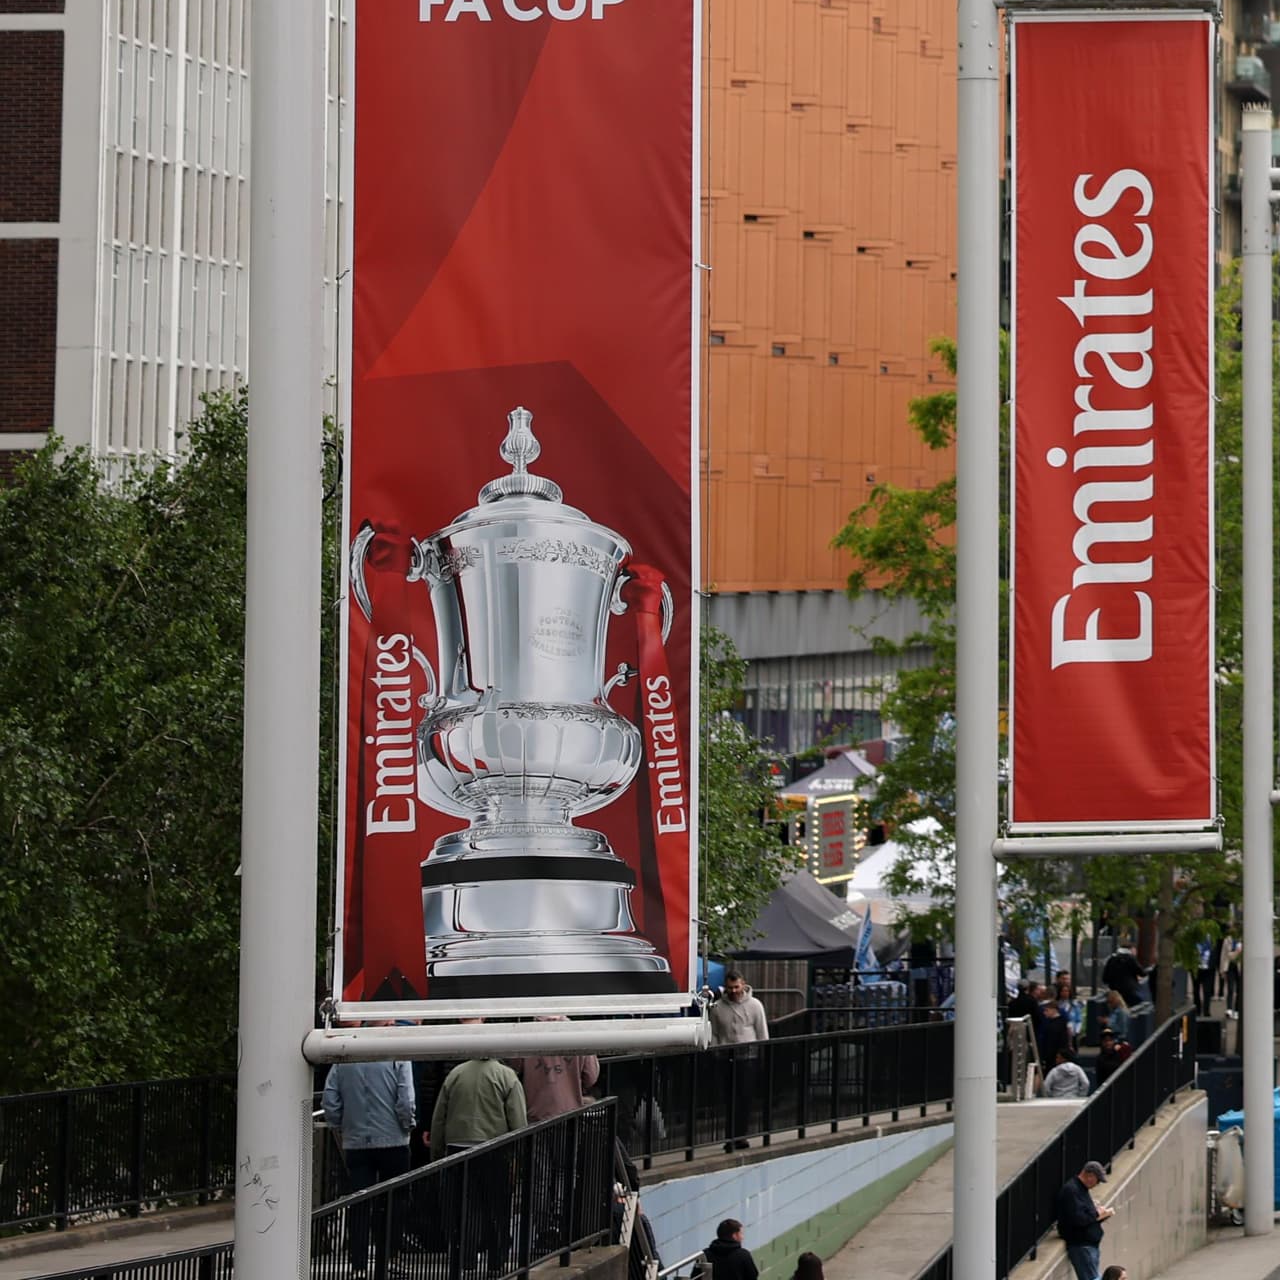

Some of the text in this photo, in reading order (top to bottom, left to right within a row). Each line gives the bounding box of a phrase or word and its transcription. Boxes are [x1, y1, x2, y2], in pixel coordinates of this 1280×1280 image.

[1046, 168, 1154, 669] Emirates
[366, 633, 417, 837] Emirates
[648, 673, 687, 836] Emirates
